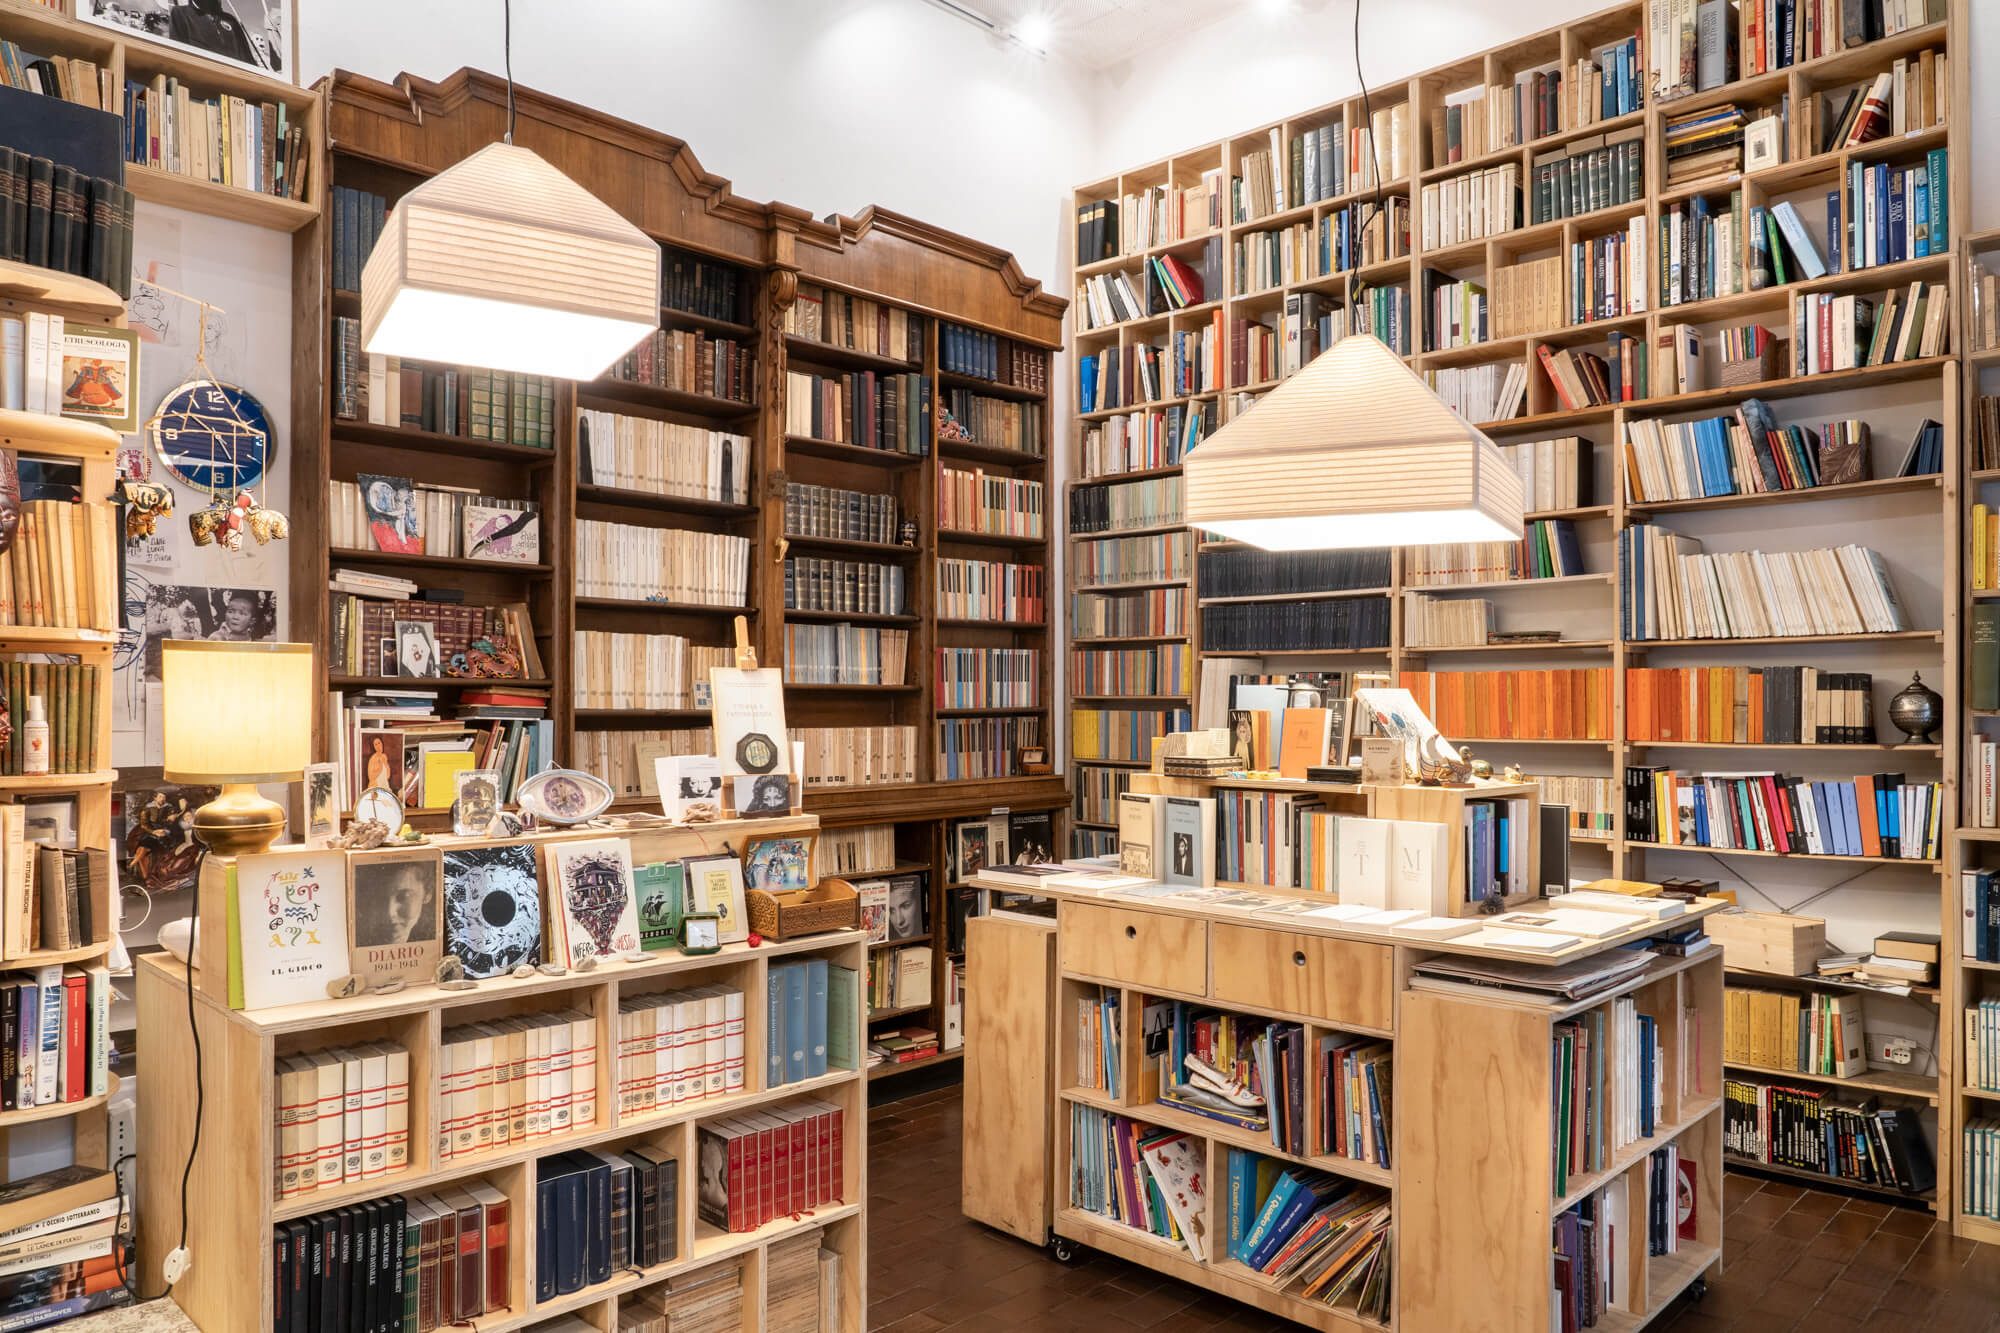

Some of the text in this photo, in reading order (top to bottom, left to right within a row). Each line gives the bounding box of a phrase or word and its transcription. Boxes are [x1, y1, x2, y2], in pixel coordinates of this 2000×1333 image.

[1785, 32, 1793, 58] TEMPESTA
[64, 336, 126, 349] ETRUSCOLOGIA
[206, 391, 225, 403] 12
[213, 472, 225, 484] 6
[367, 946, 425, 964] DIARIO
[271, 963, 323, 975] IL GIOCO
[42, 985, 61, 1053] VALERIAN
[1232, 1182, 1240, 1213] Quadro
[67, 1209, 99, 1221] SOTTERRANEO
[1262, 1200, 1279, 1226] Quadro
[382, 1224, 390, 1243] OSCAR
[1249, 1226, 1264, 1247] Giallo
[368, 1228, 377, 1286] GEORGES BATAILLE
